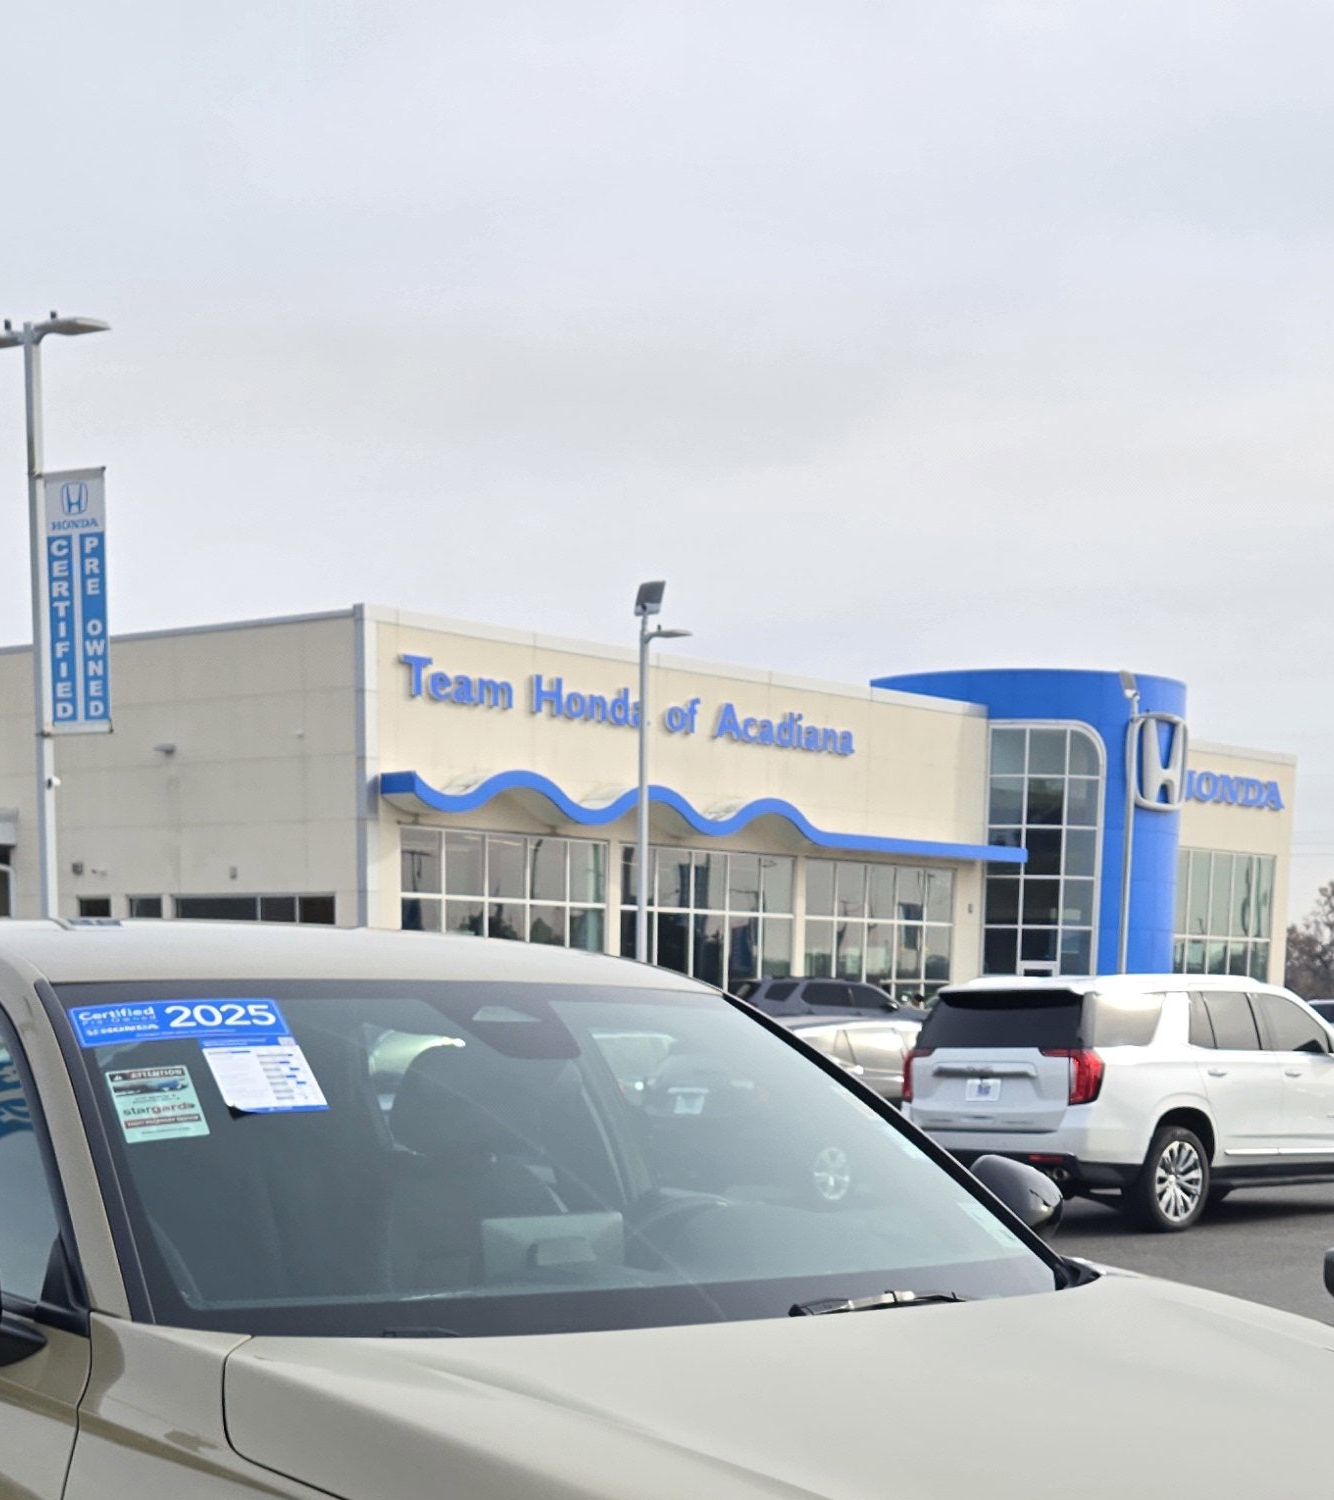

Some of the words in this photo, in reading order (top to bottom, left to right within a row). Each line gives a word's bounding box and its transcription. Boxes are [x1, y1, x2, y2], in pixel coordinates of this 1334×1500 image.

[51, 518, 99, 531] HONDA
[84, 536, 100, 596] PRE
[51, 538, 74, 719] CERTIFIED
[85, 618, 105, 717] OWNED
[400, 654, 514, 709] Team
[666, 698, 702, 735] of
[714, 702, 856, 757] Acadiana
[78, 1006, 155, 1021] Certified
[165, 1003, 277, 1029] 2025
